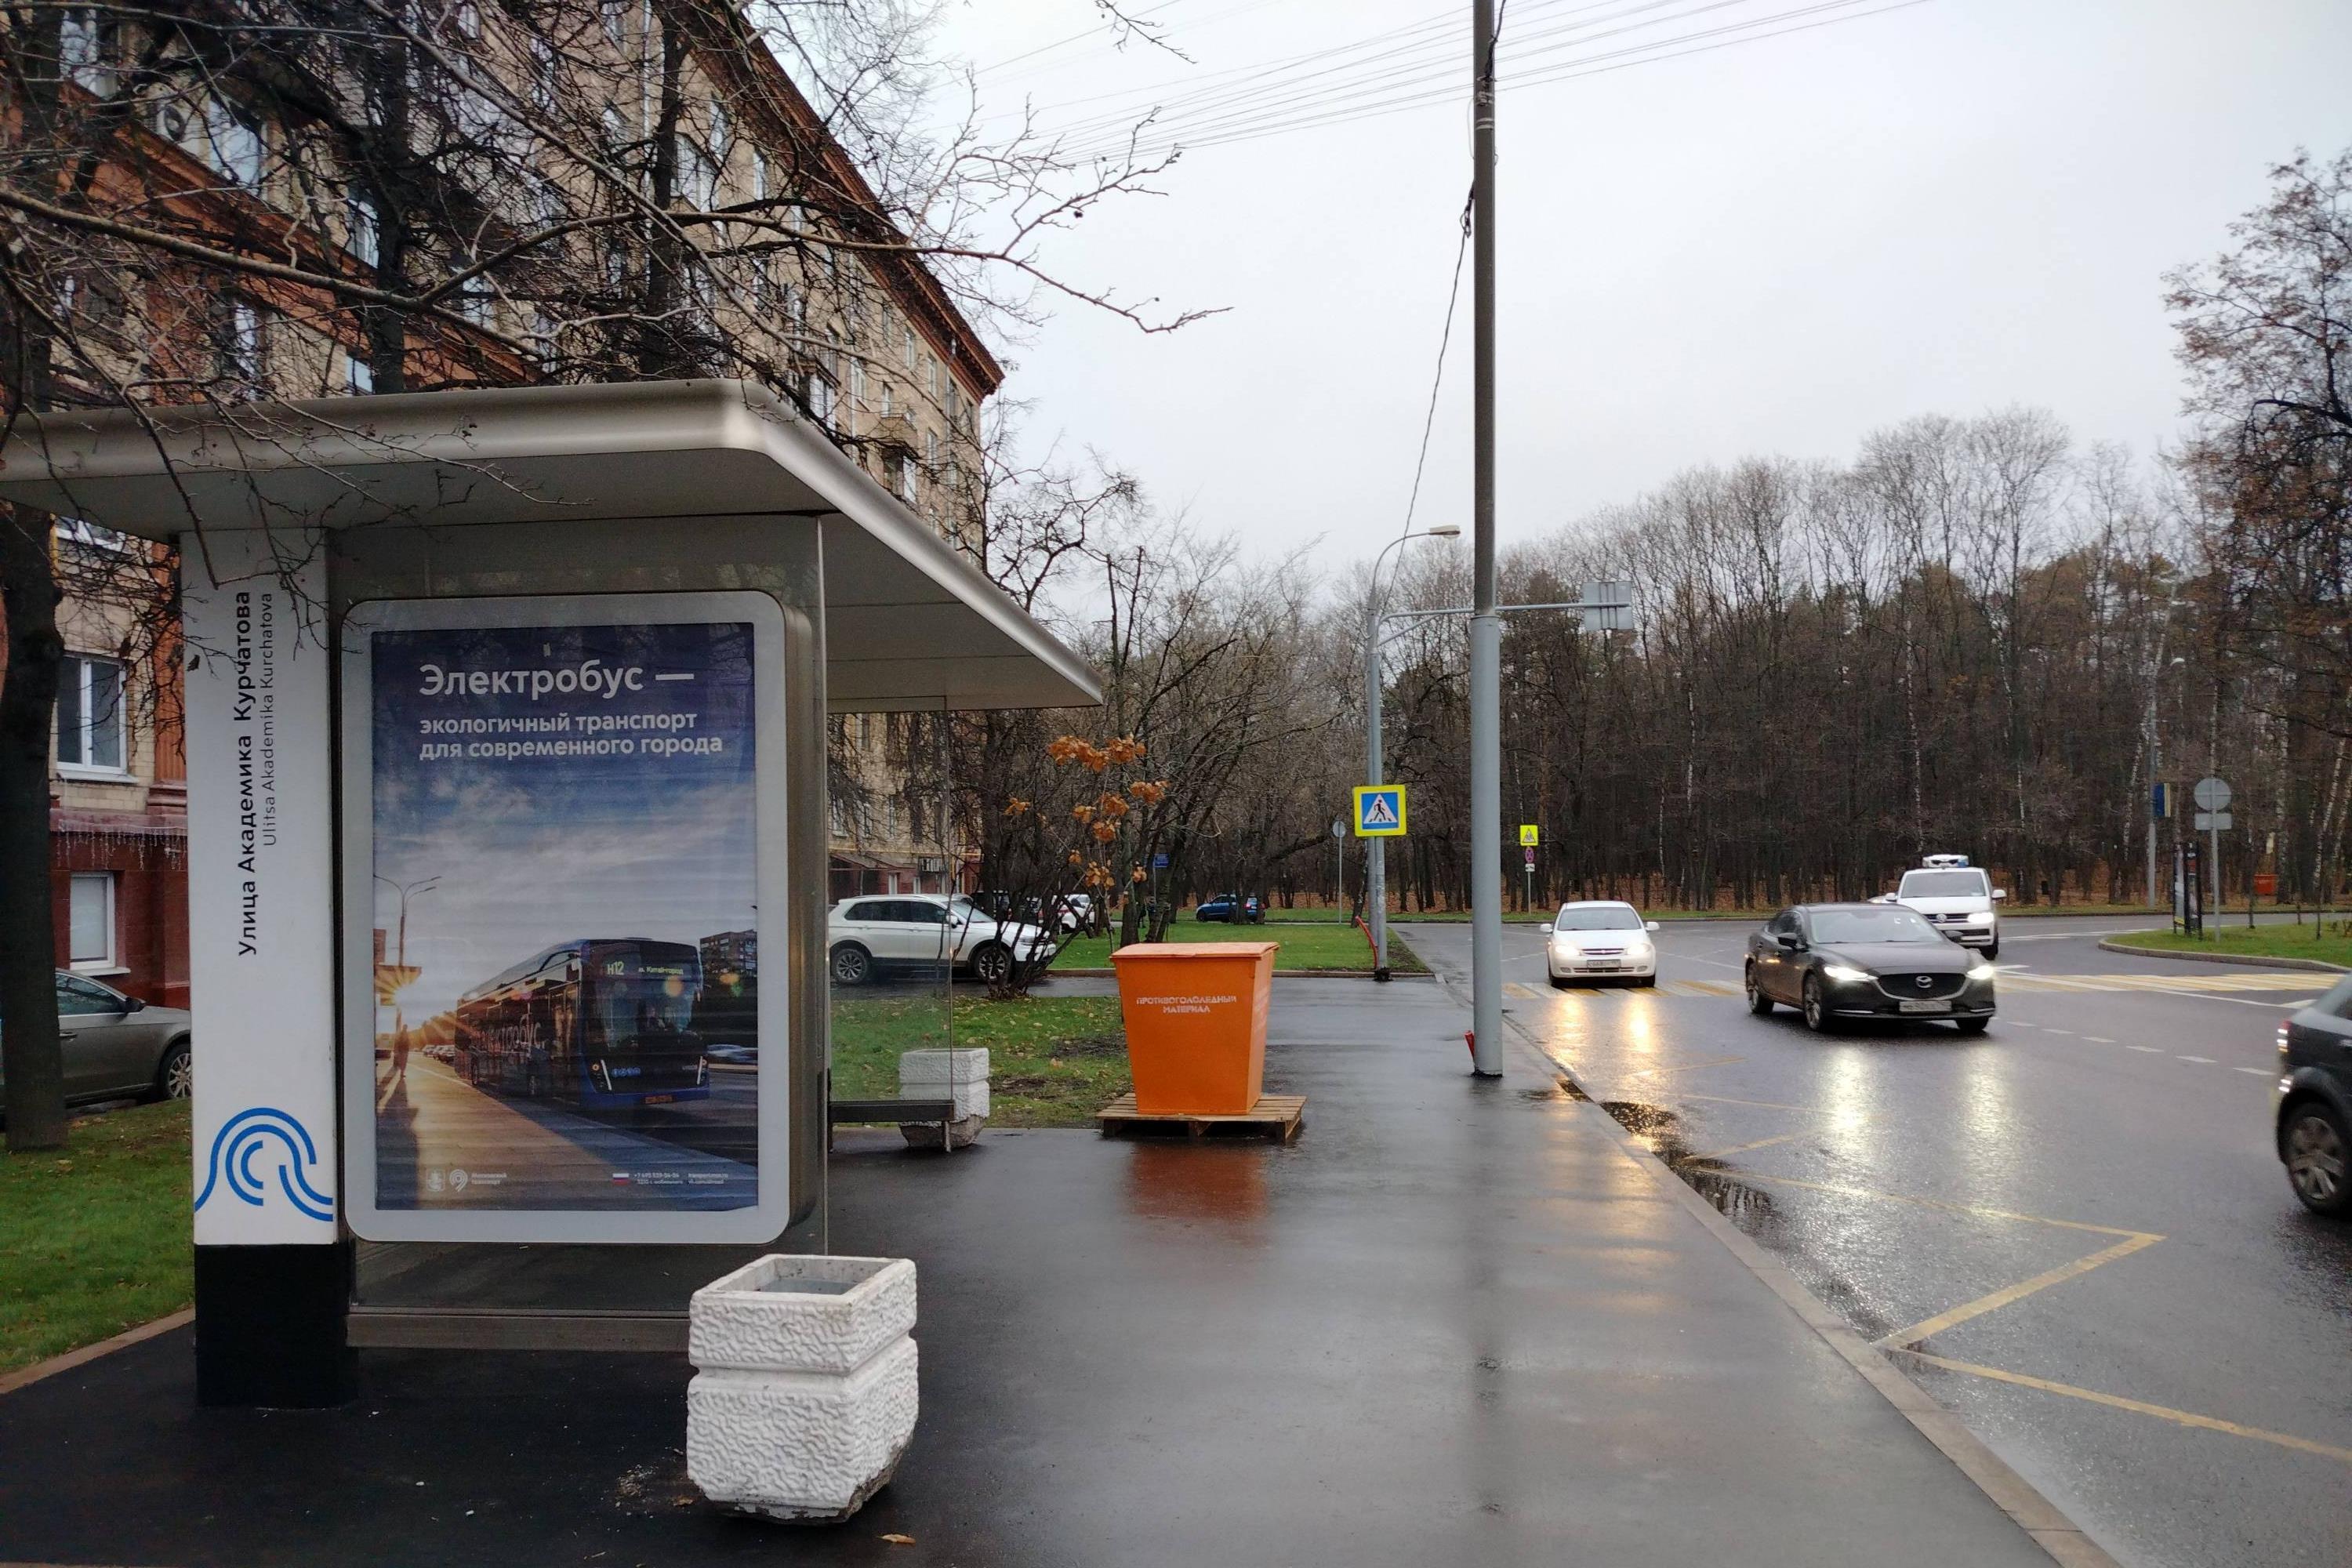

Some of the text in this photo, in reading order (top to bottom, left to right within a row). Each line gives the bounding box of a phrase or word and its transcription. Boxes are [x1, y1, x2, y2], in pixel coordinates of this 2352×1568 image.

[419, 659, 644, 700] Электробус
[259, 593, 277, 847] Ulitsa Akademika Kurchatova
[419, 712, 697, 735] экологичный транспорт
[419, 736, 723, 761] для современного города
[234, 591, 257, 956] Улица Академика Курчатова
[1163, 1005, 1210, 1014] МАТЕРИАЛ
